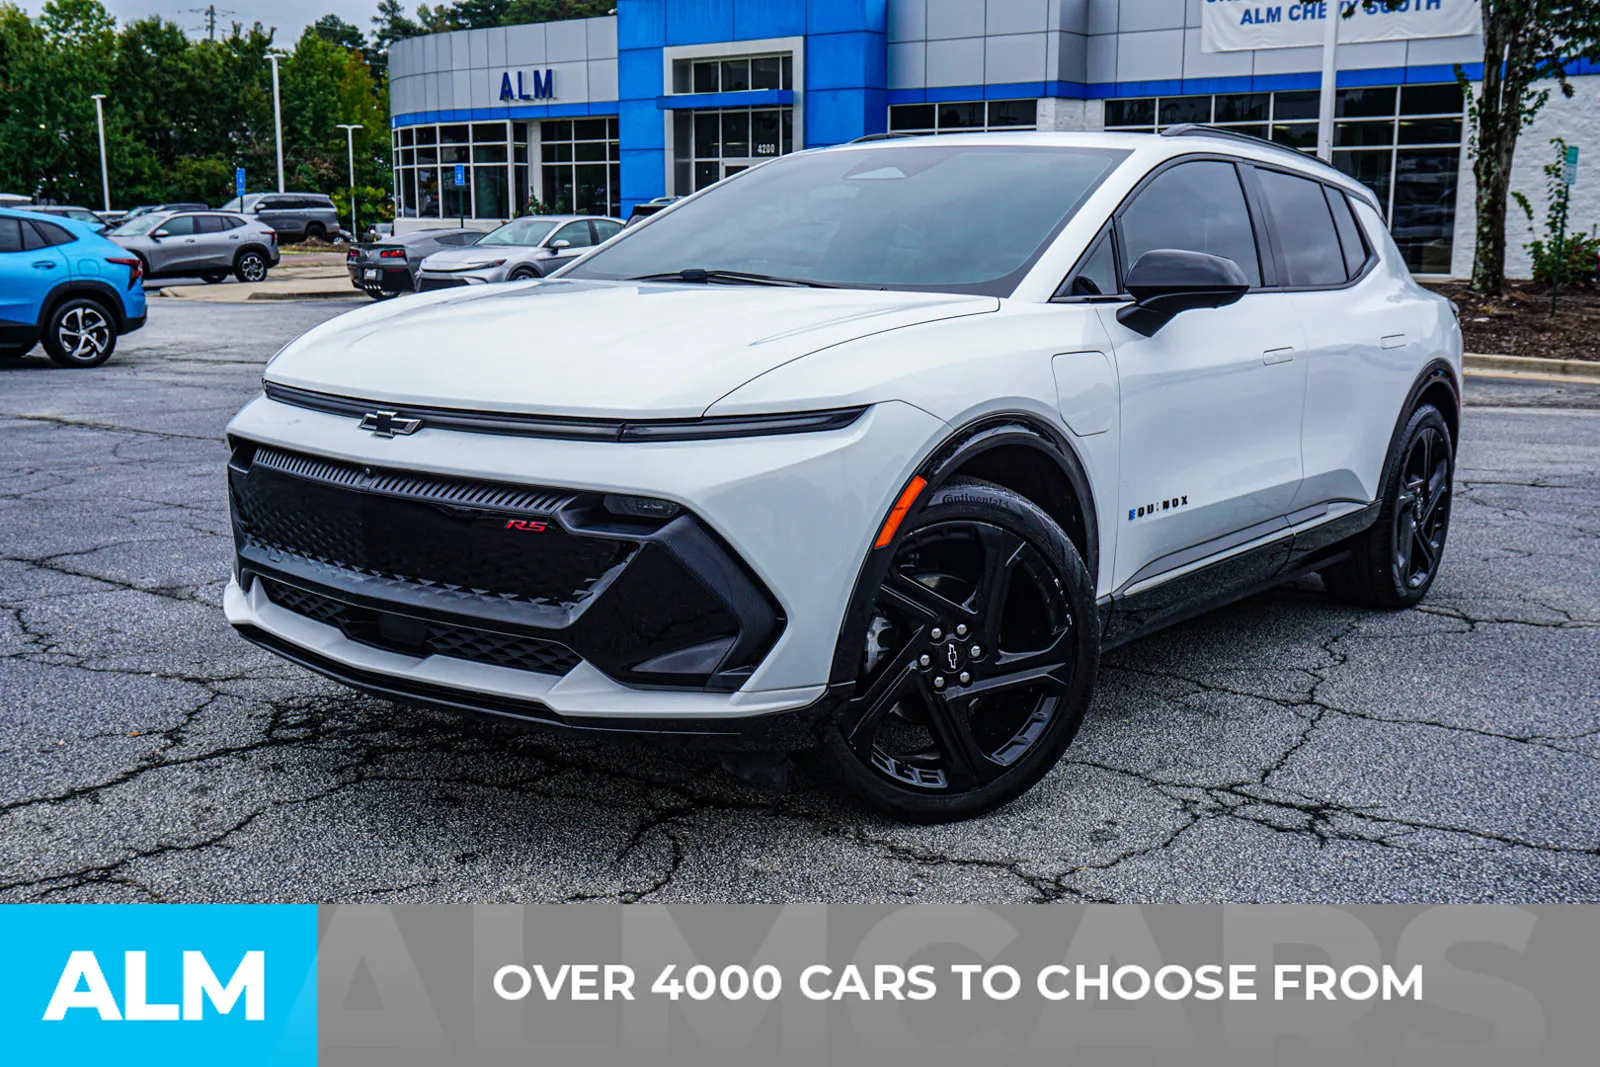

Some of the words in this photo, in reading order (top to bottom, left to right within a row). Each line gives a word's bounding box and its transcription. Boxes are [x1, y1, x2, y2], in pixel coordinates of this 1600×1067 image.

[1240, 6, 1281, 25] ALM
[499, 69, 553, 101] ALM
[757, 143, 775, 154] 4200
[942, 493, 1003, 507] Continental
[505, 519, 548, 532] RS
